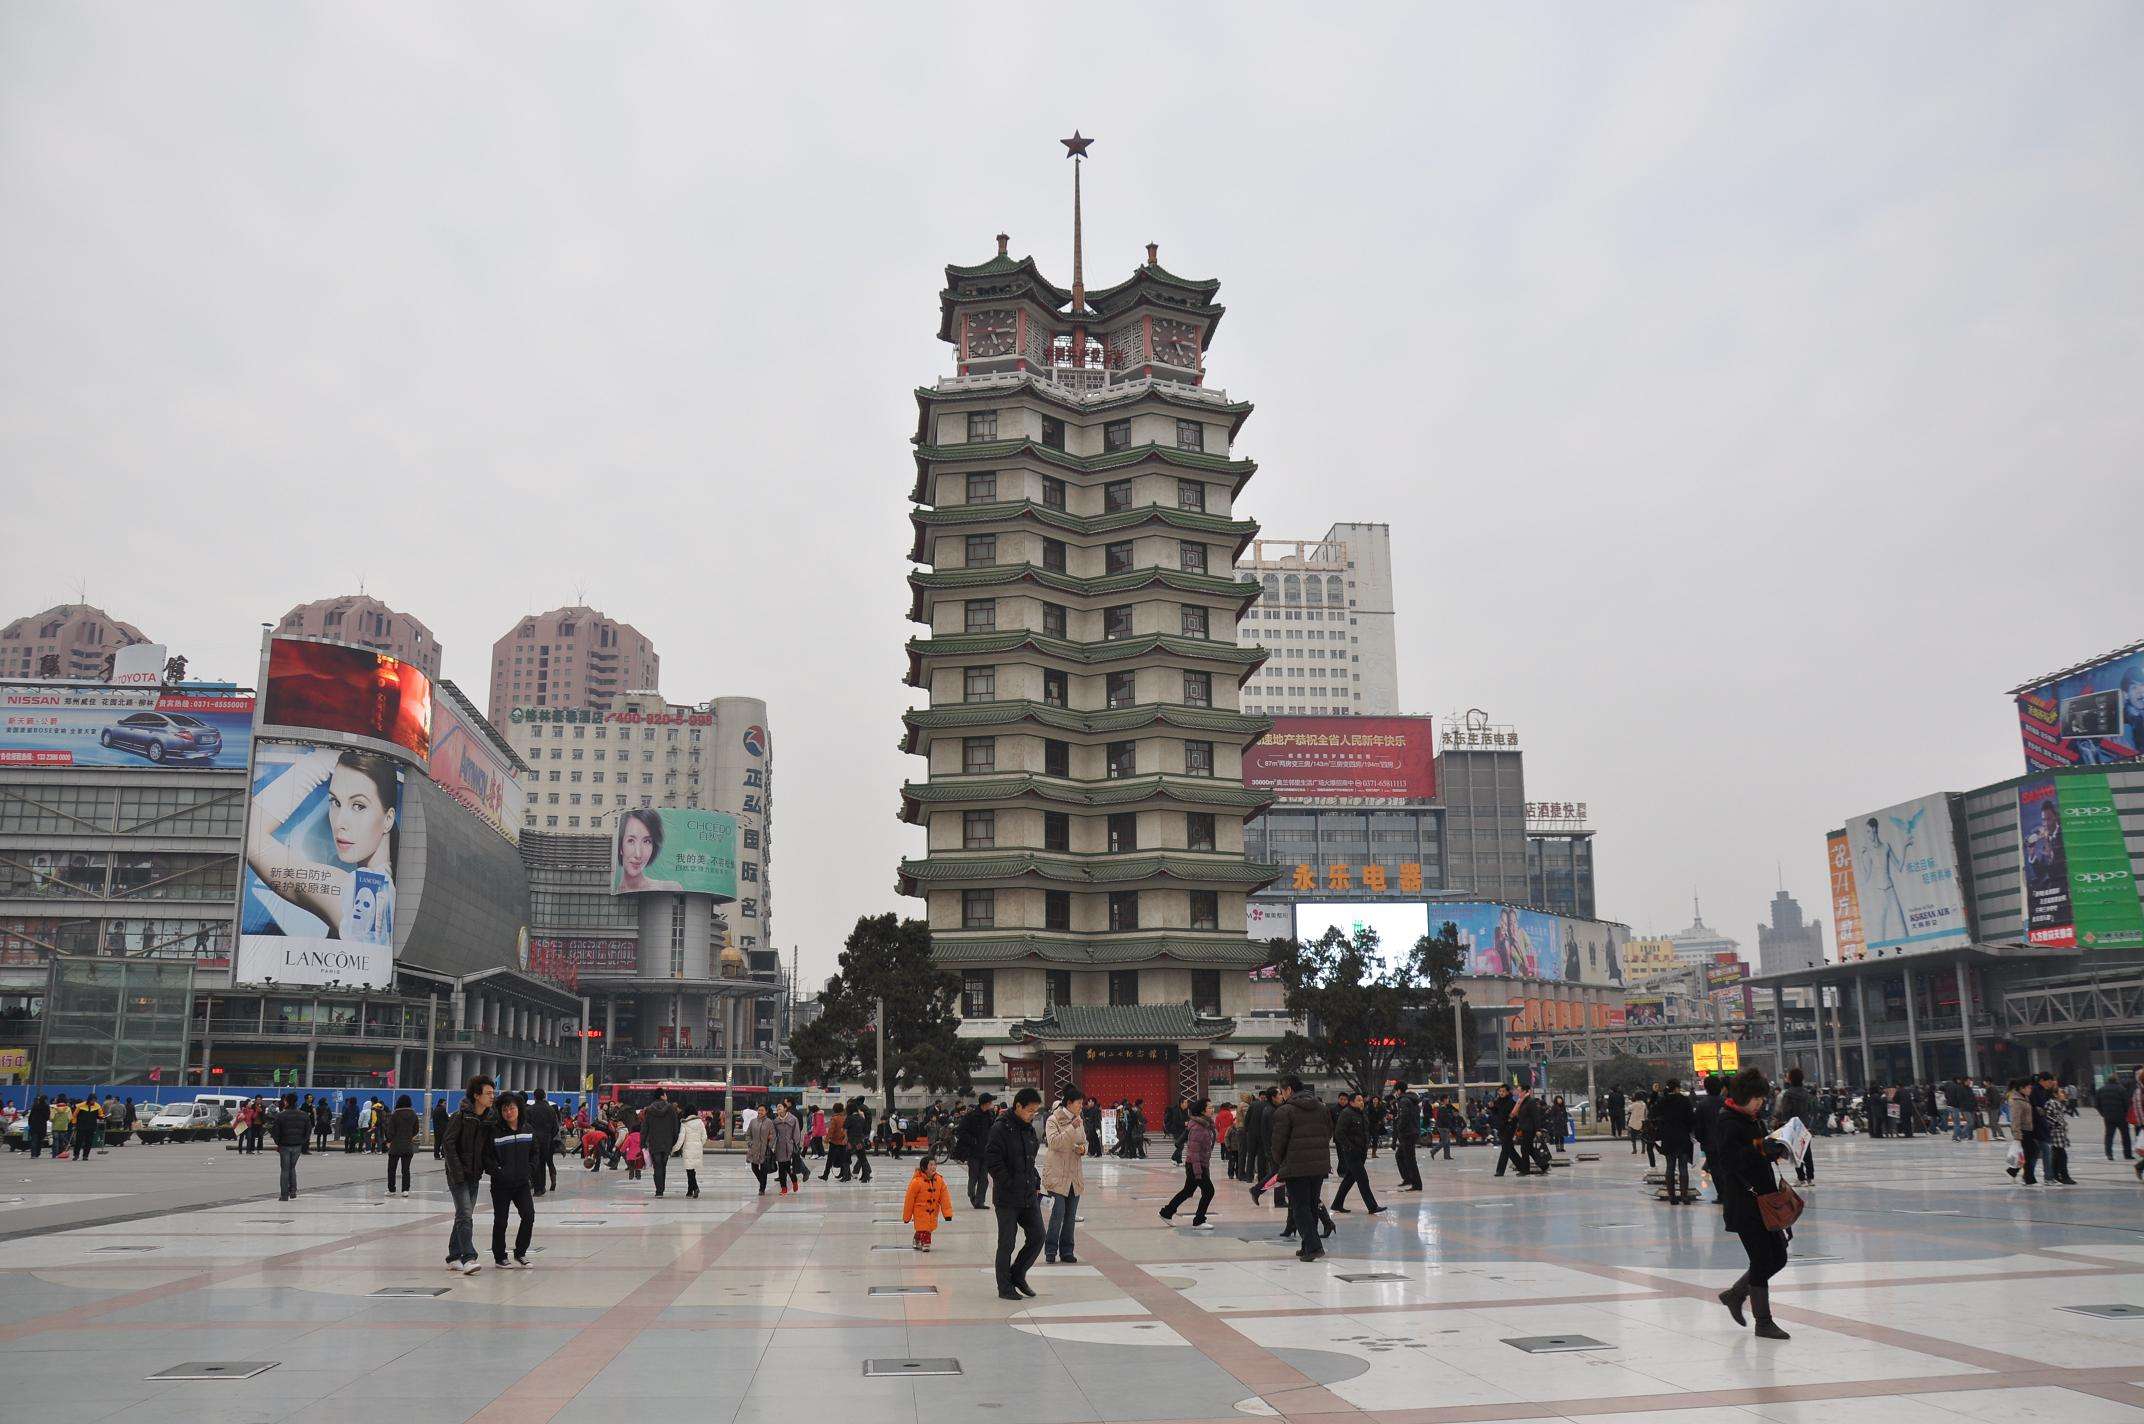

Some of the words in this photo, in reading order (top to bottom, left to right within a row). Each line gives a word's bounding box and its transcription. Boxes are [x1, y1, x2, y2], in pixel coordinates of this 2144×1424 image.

[118, 673, 157, 684] TOYOTA
[7, 696, 60, 705] NISSAN
[271, 867, 332, 881] 新美白防护
[285, 949, 370, 972] LANCÔME
